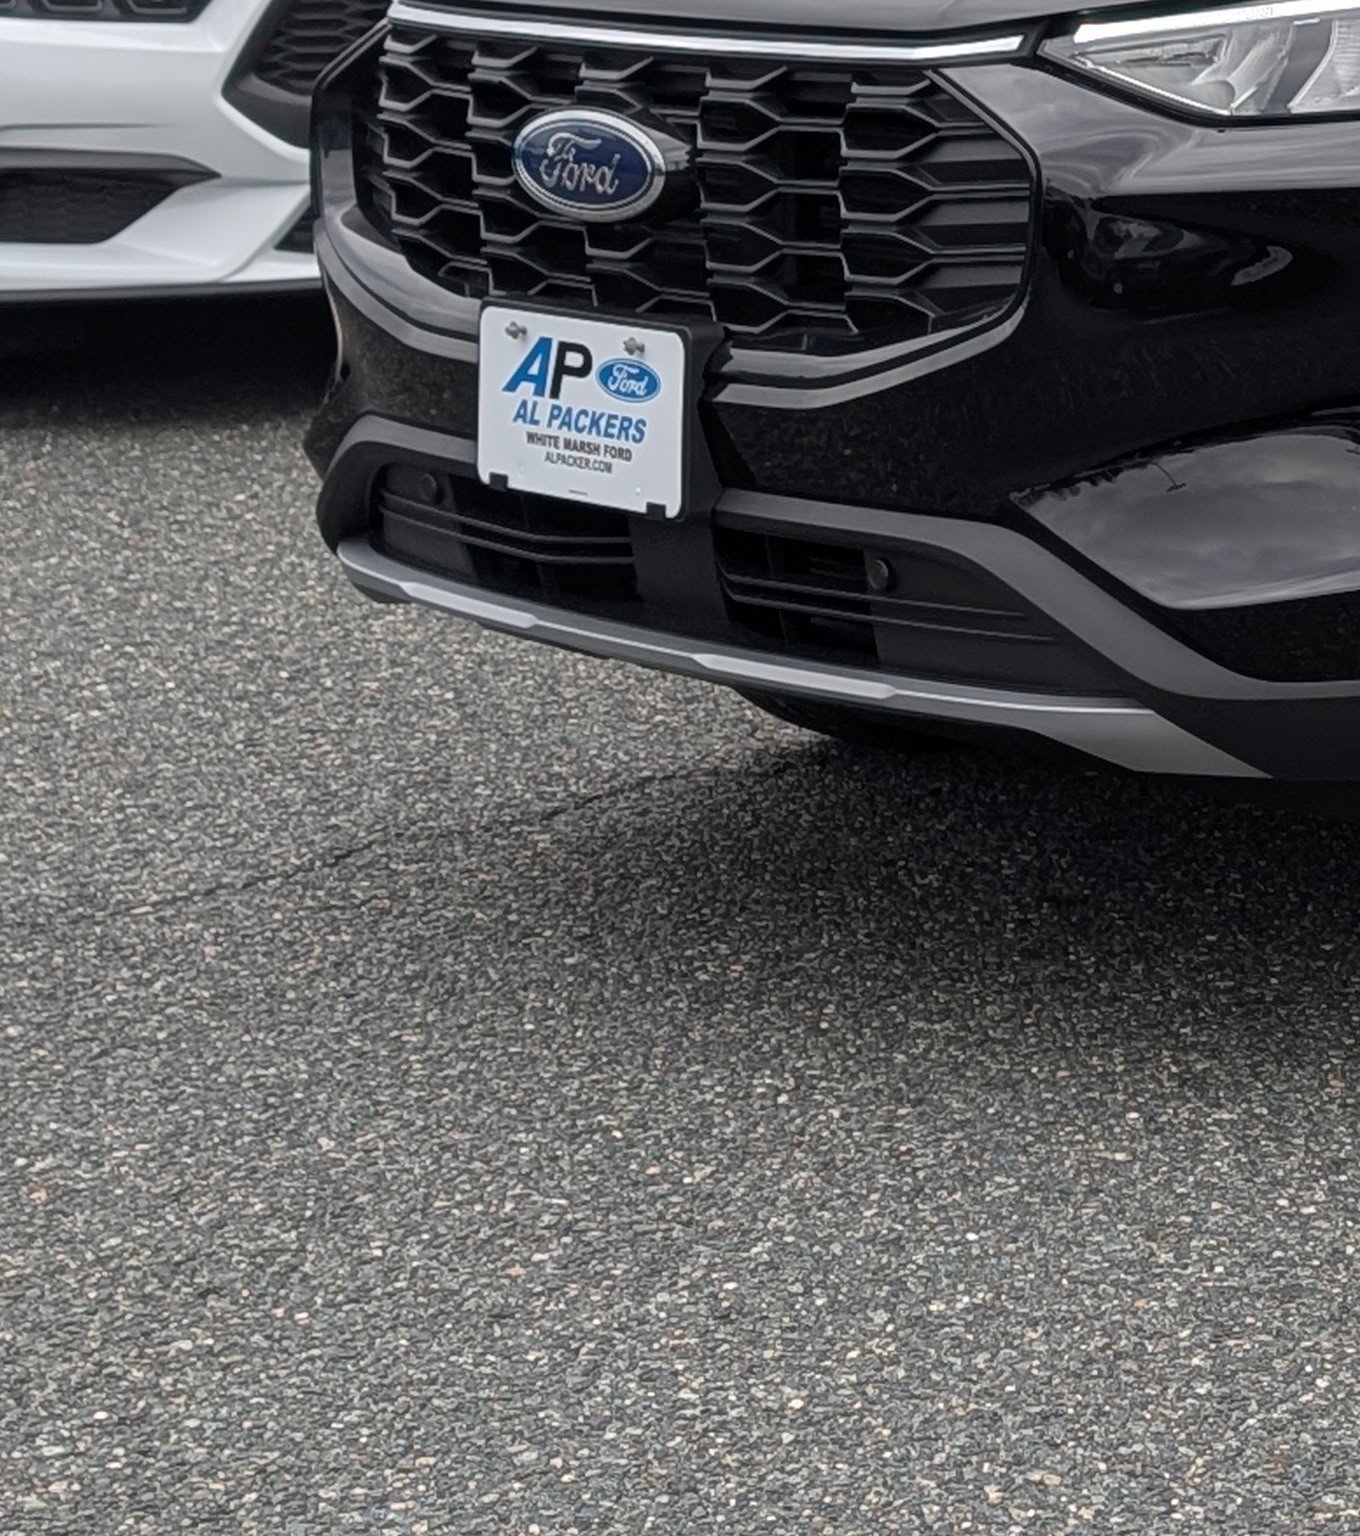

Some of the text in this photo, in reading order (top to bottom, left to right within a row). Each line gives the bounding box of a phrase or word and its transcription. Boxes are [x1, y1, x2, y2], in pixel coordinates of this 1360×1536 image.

[540, 132, 620, 195] Ford
[502, 335, 593, 400] AP
[512, 399, 647, 445] AL PACKERS
[526, 430, 633, 463] WHITE MARSH FORD
